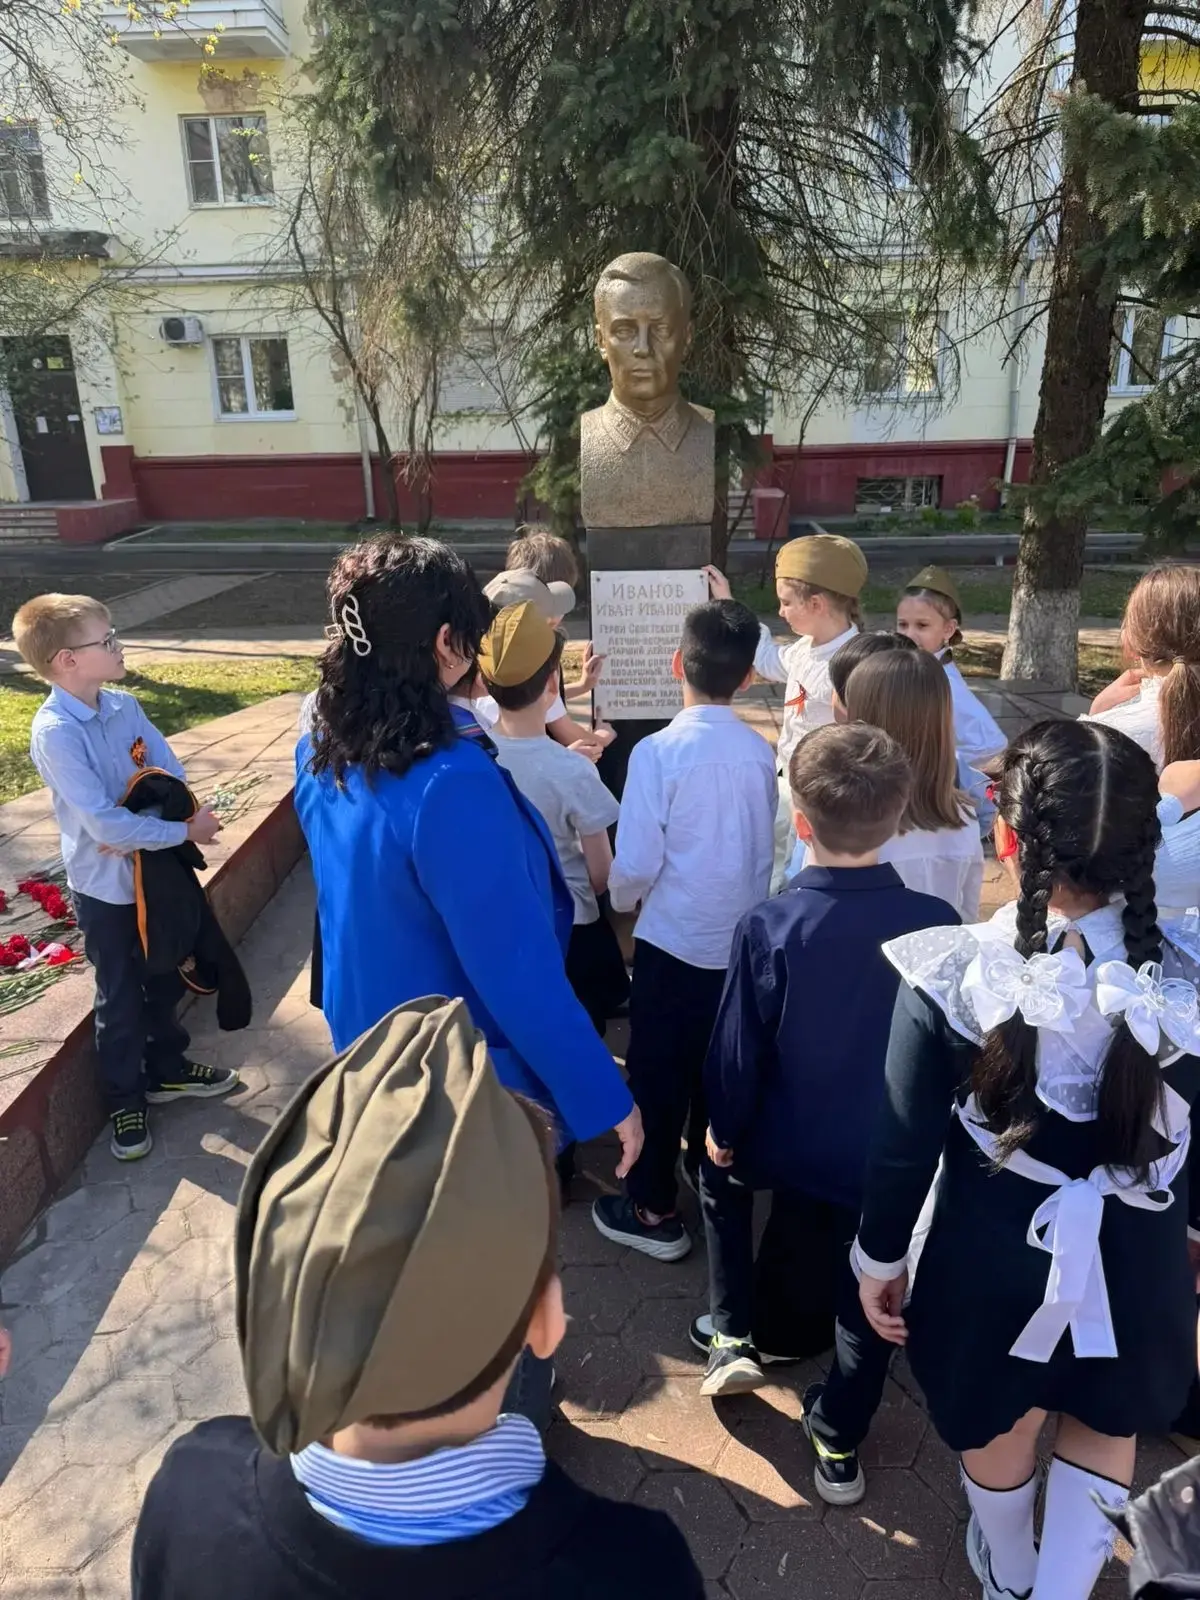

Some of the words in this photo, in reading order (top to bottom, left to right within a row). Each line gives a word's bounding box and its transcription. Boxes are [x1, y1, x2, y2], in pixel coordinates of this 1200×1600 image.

[612, 583, 684, 600] ИВАНОВ
[596, 603, 634, 616] ИВАН
[639, 602, 698, 616] ИВАНОВ
[608, 637, 683, 646] ЛЕТЧИК-ИСТРЕБИТ
[647, 646, 677, 654] ЛЕЙТЕН
[660, 677, 684, 686] САМО
